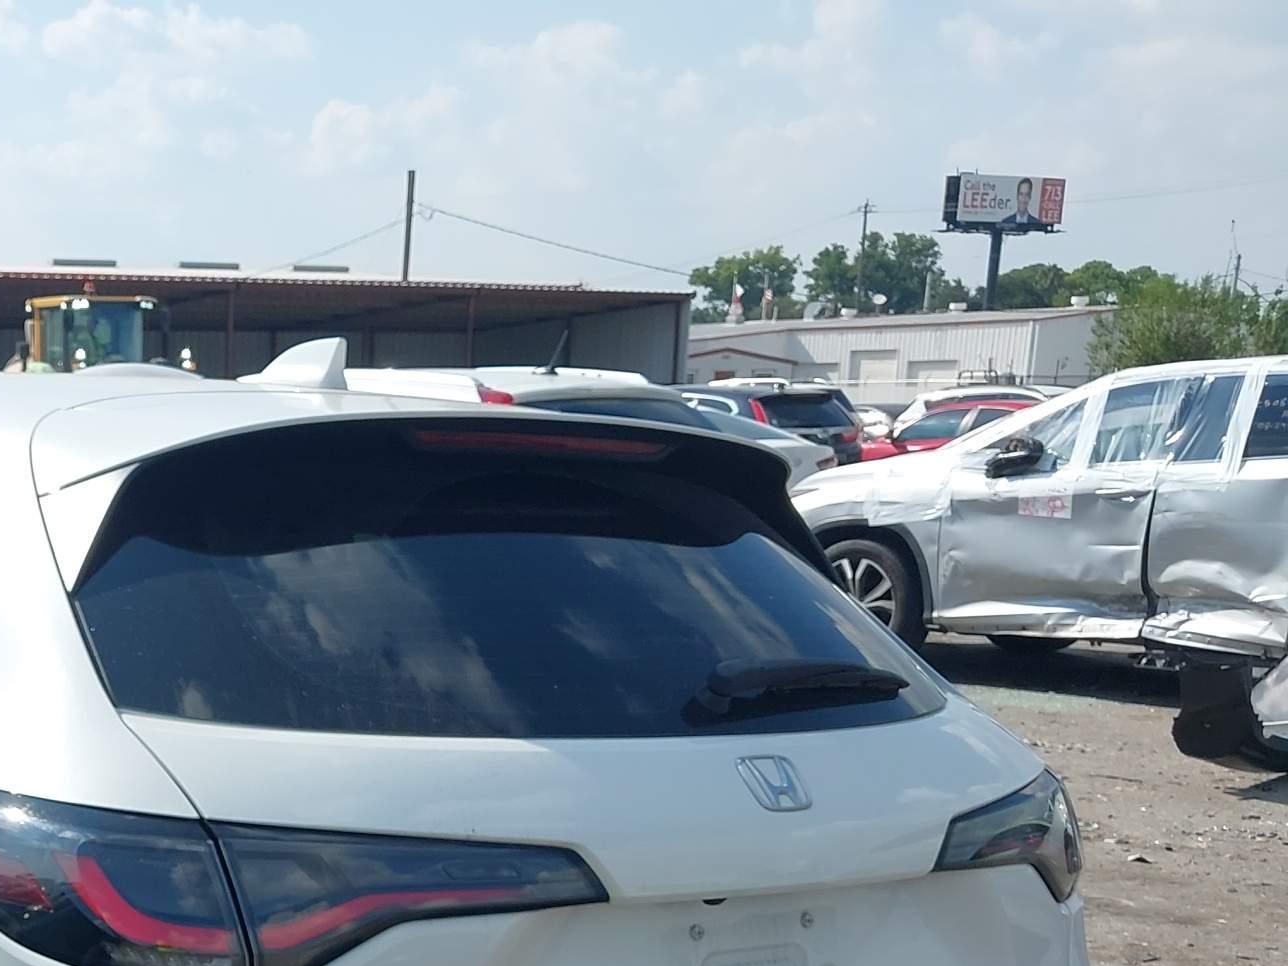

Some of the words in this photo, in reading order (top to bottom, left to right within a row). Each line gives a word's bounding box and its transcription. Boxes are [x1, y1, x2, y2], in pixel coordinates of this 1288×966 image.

[964, 180, 981, 191] Call
[982, 181, 996, 192] the
[1044, 186, 1062, 201] 713
[1041, 210, 1060, 223] LEE
